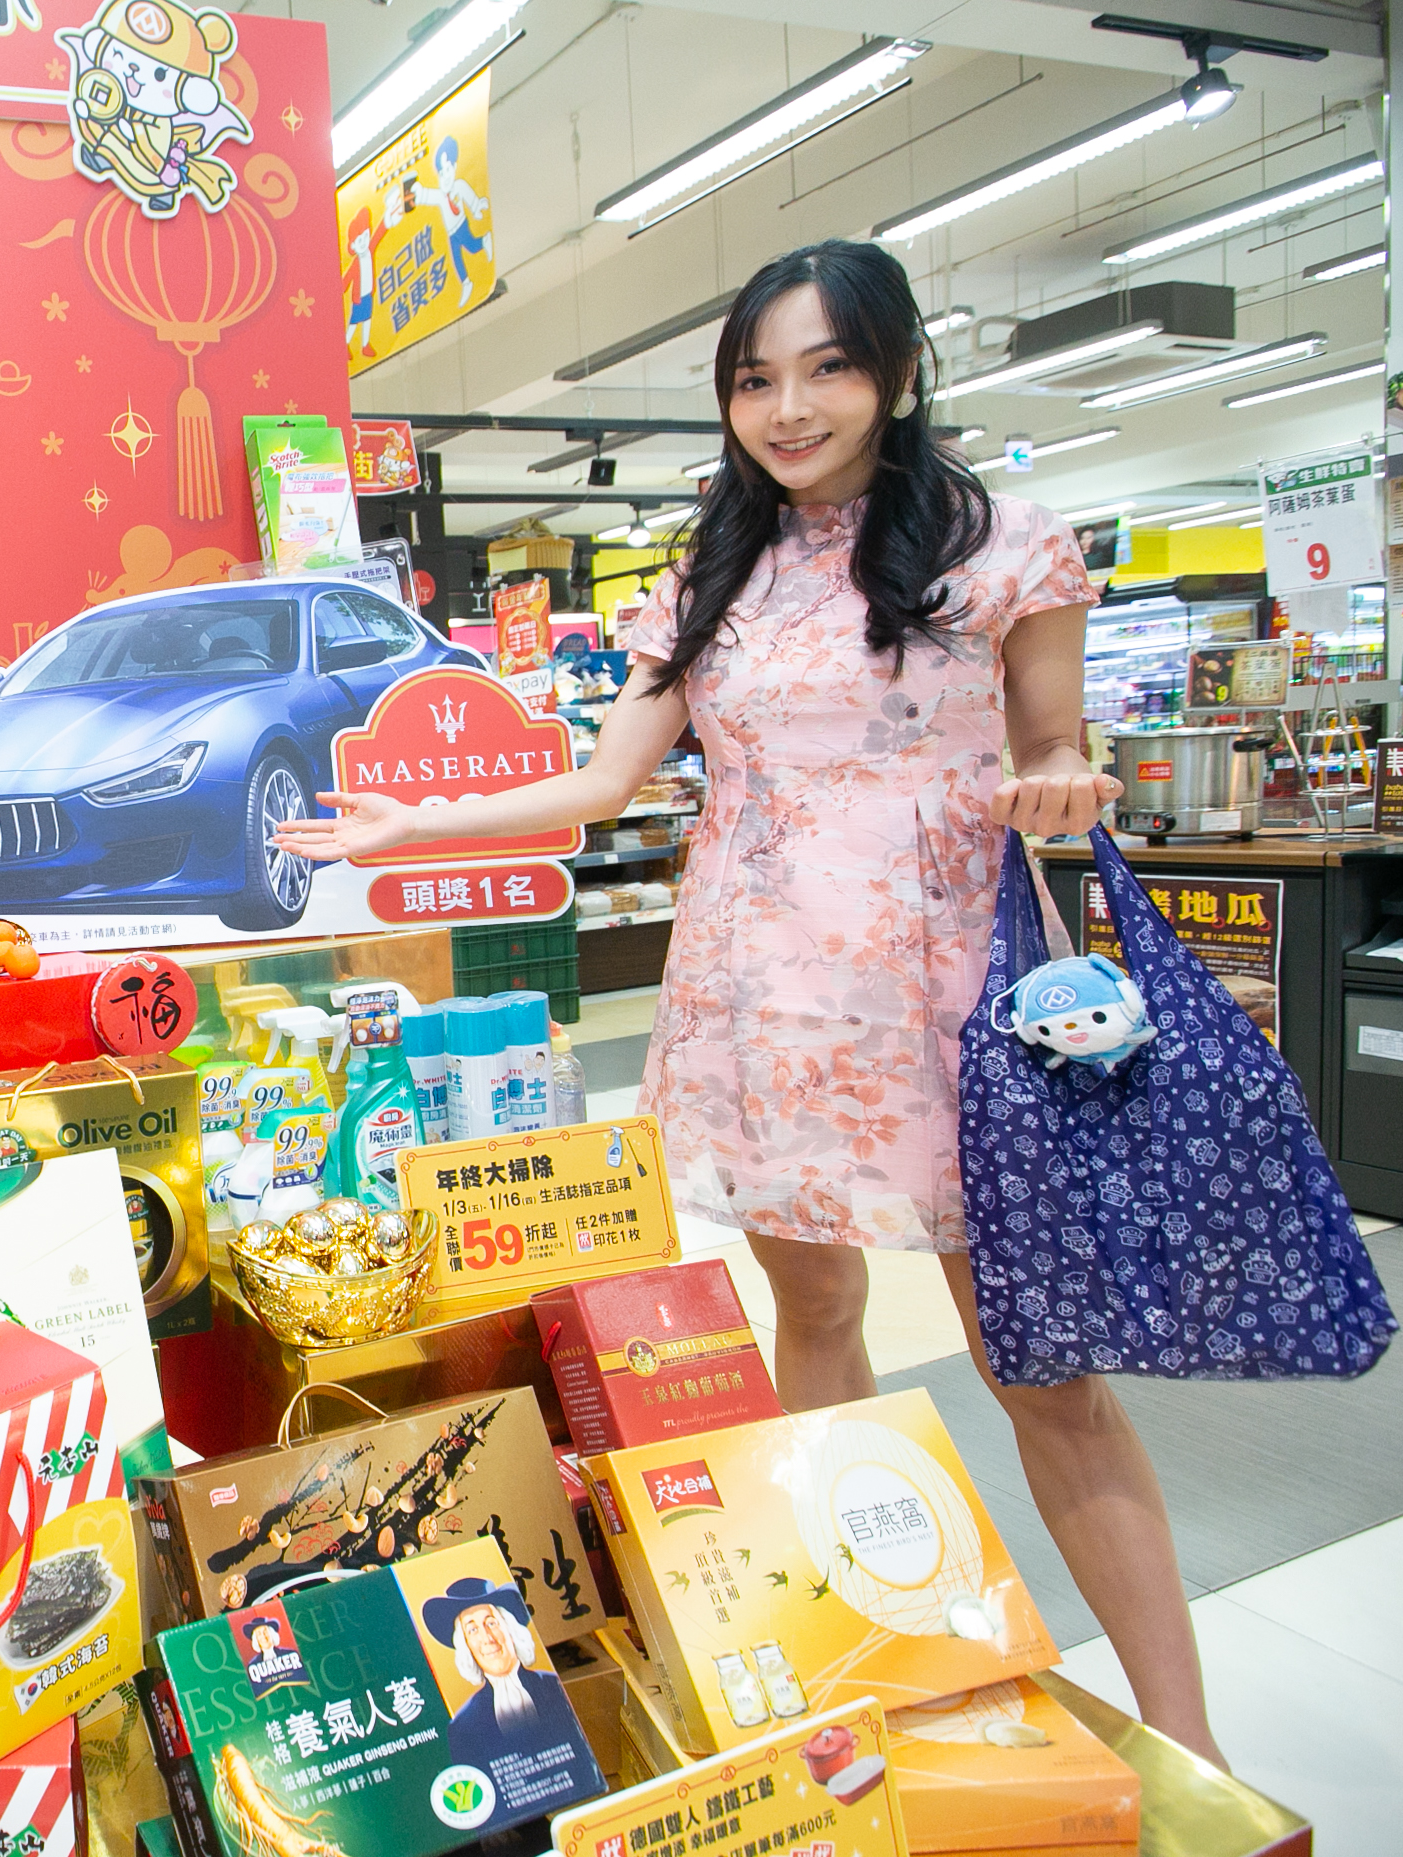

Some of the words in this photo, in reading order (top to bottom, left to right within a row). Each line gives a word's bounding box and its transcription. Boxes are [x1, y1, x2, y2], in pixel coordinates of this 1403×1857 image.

[375, 122, 428, 178] COFFEE
[378, 225, 435, 305] 自己做
[391, 255, 448, 333] 省更多
[1299, 458, 1366, 484] 生鮮特賣
[1268, 483, 1356, 518] 阿薩姆茶葉蛋
[1307, 542, 1331, 581] 9
[507, 672, 548, 693] xpay
[1216, 685, 1229, 702] 9
[355, 750, 557, 785] MASERATI
[401, 874, 536, 914] 頭獎1名
[109, 971, 181, 1045] 福
[58, 1118, 132, 1149] Olive
[138, 1106, 178, 1137] Oil
[369, 1124, 413, 1145] 魔術靈
[436, 1154, 555, 1192] 年終大掃除
[539, 1176, 632, 1204] 生活誌指定品項
[525, 1222, 558, 1243] 折起
[575, 1208, 638, 1231] 任2件加贈
[593, 1227, 641, 1247] 印花1枚
[444, 1224, 463, 1273] 全聯價
[462, 1218, 524, 1271] 59
[34, 1312, 83, 1331] GREEN
[88, 1302, 133, 1320] LABEL
[80, 1334, 96, 1348] 15
[38, 1440, 99, 1484] 元本山
[655, 1473, 713, 1506] 天地合補
[841, 1496, 928, 1544] 官燕窩
[858, 1546, 872, 1556] THE
[872, 1540, 895, 1552] FINEST
[918, 1531, 935, 1542] NEST
[41, 1633, 109, 1690] 韓式海苔
[249, 1652, 303, 1683] QUAKER
[285, 1675, 425, 1760] 養氣人蔘
[265, 1720, 293, 1767] 桂格
[280, 1764, 323, 1793] 滋補液
[322, 1752, 364, 1778] QUAKER
[364, 1738, 408, 1763] GINSENG
[407, 1727, 439, 1748] DRINK
